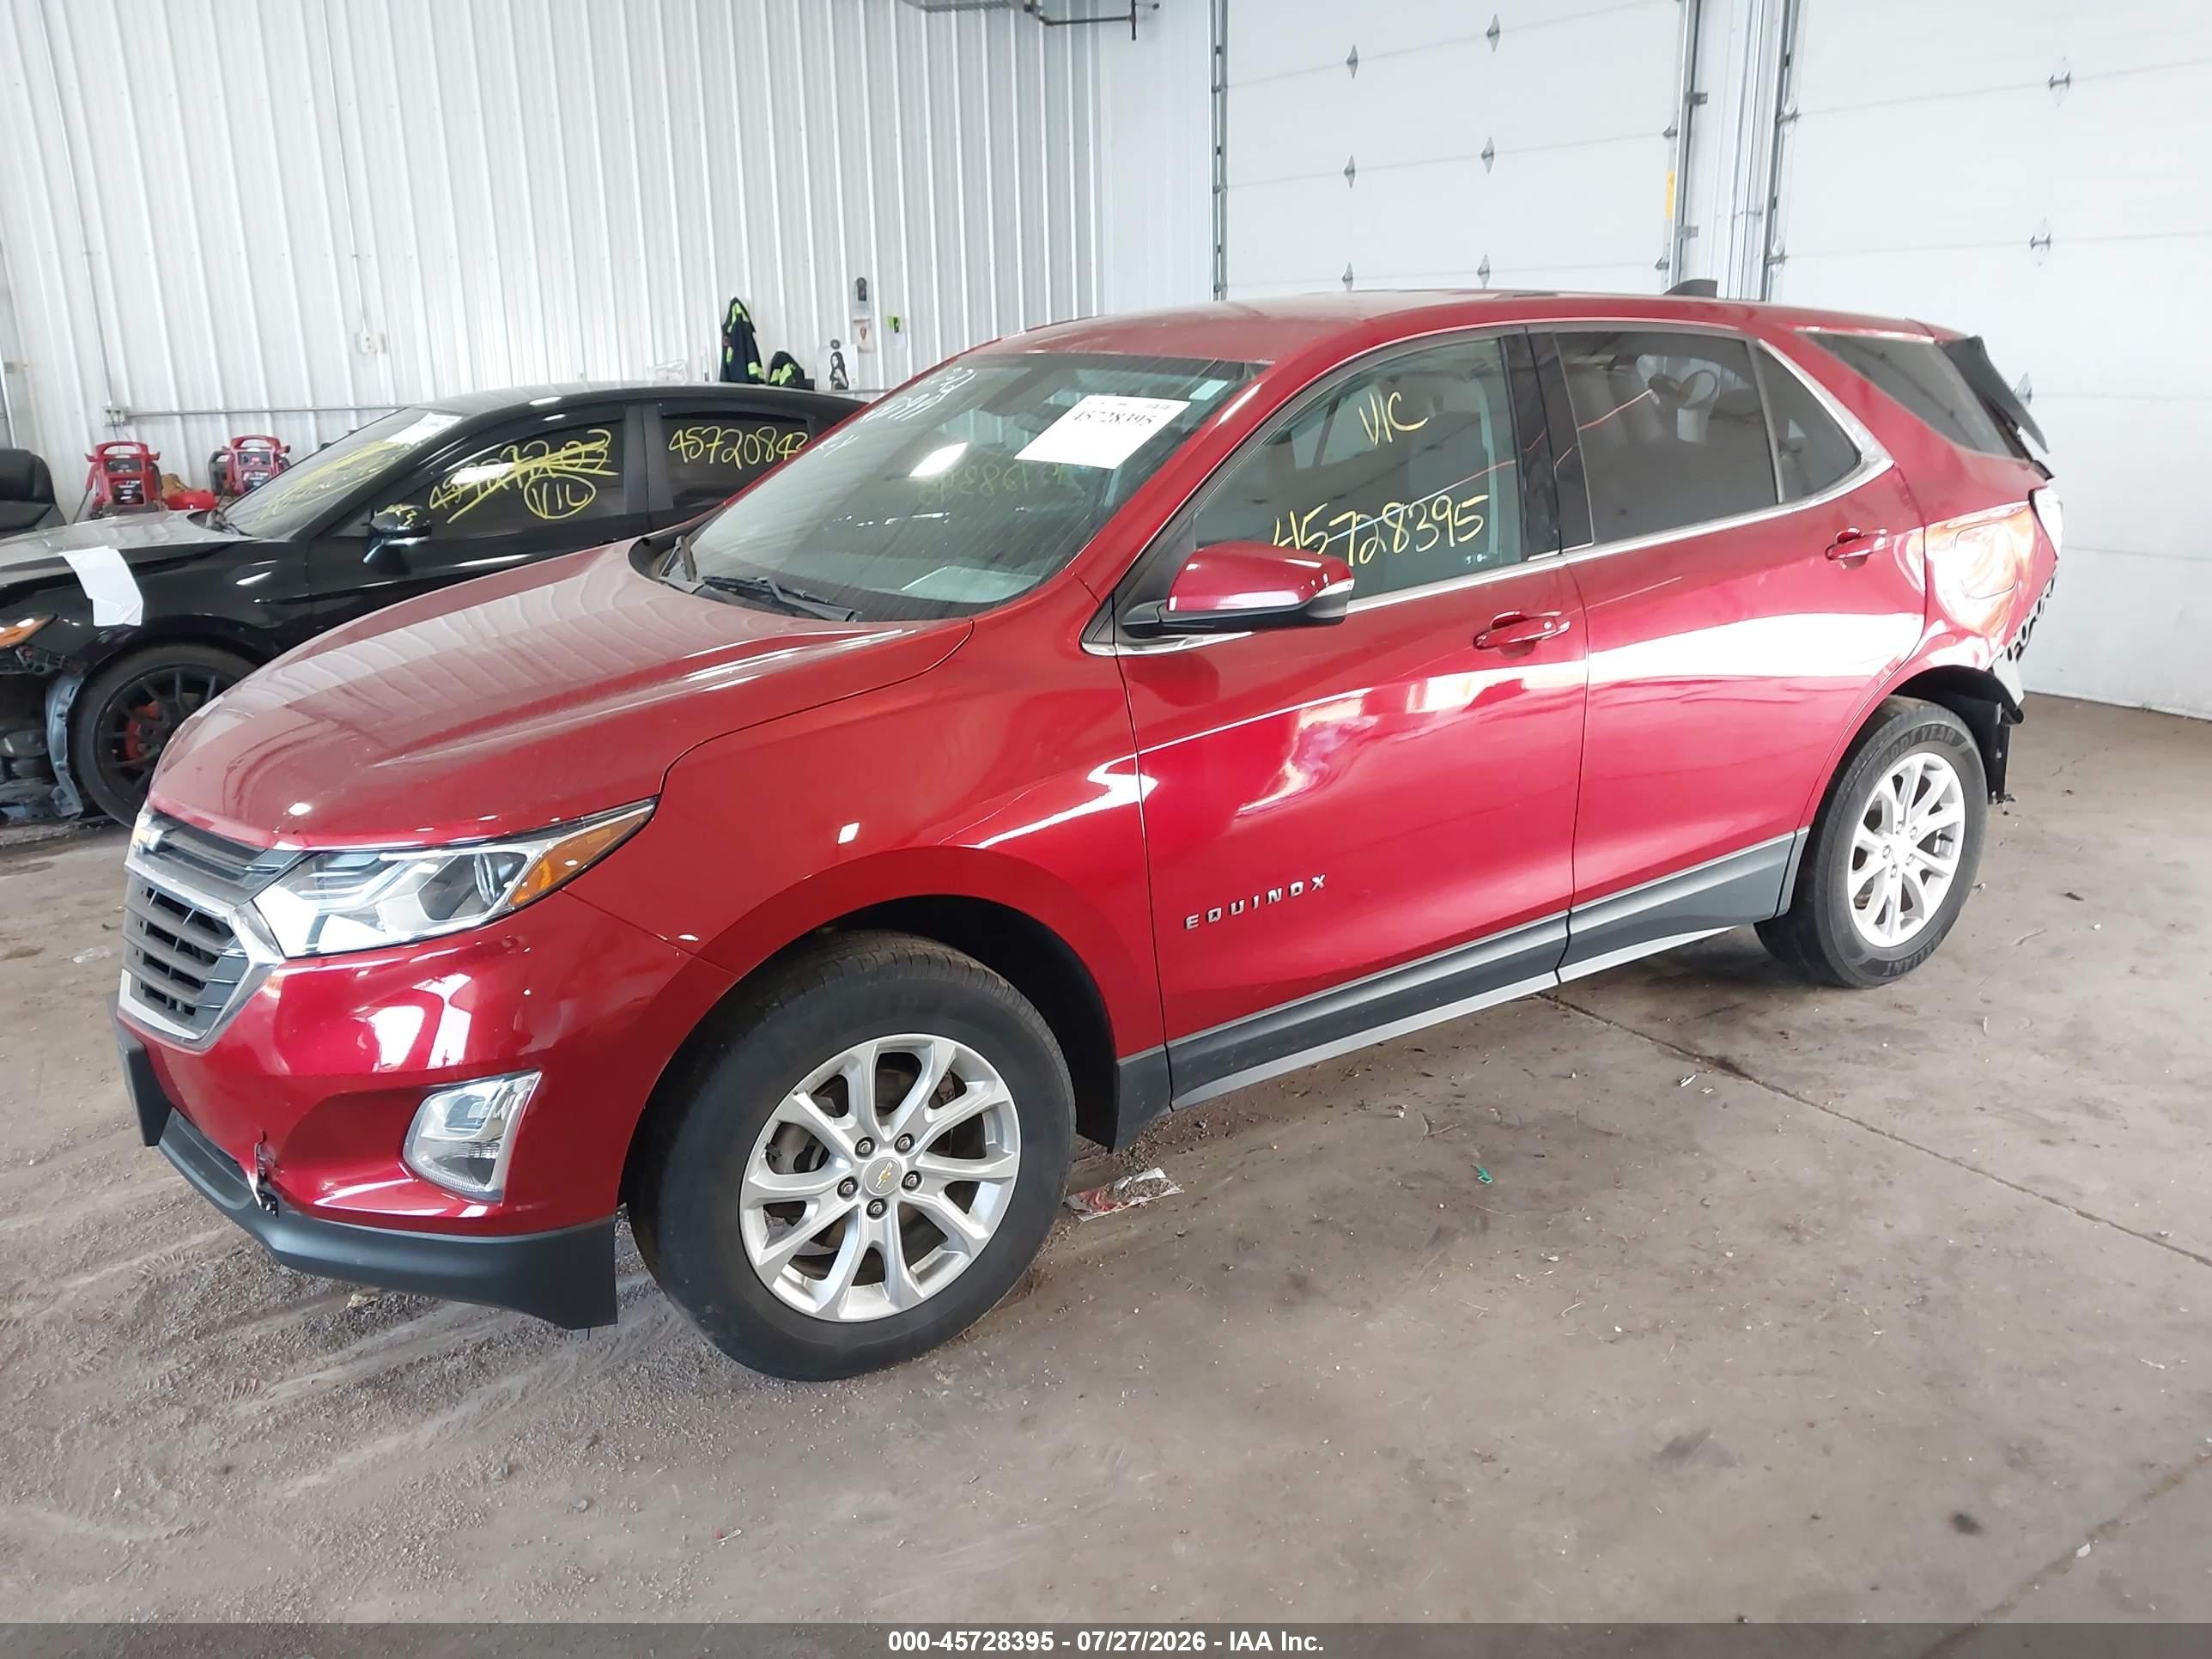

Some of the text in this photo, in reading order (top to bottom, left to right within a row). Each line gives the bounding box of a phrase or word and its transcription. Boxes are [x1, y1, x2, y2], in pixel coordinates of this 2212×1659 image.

[1358, 392, 1429, 446] VIC
[1273, 495, 1489, 568] 45728395
[1185, 874, 1326, 930] EQUINOX
